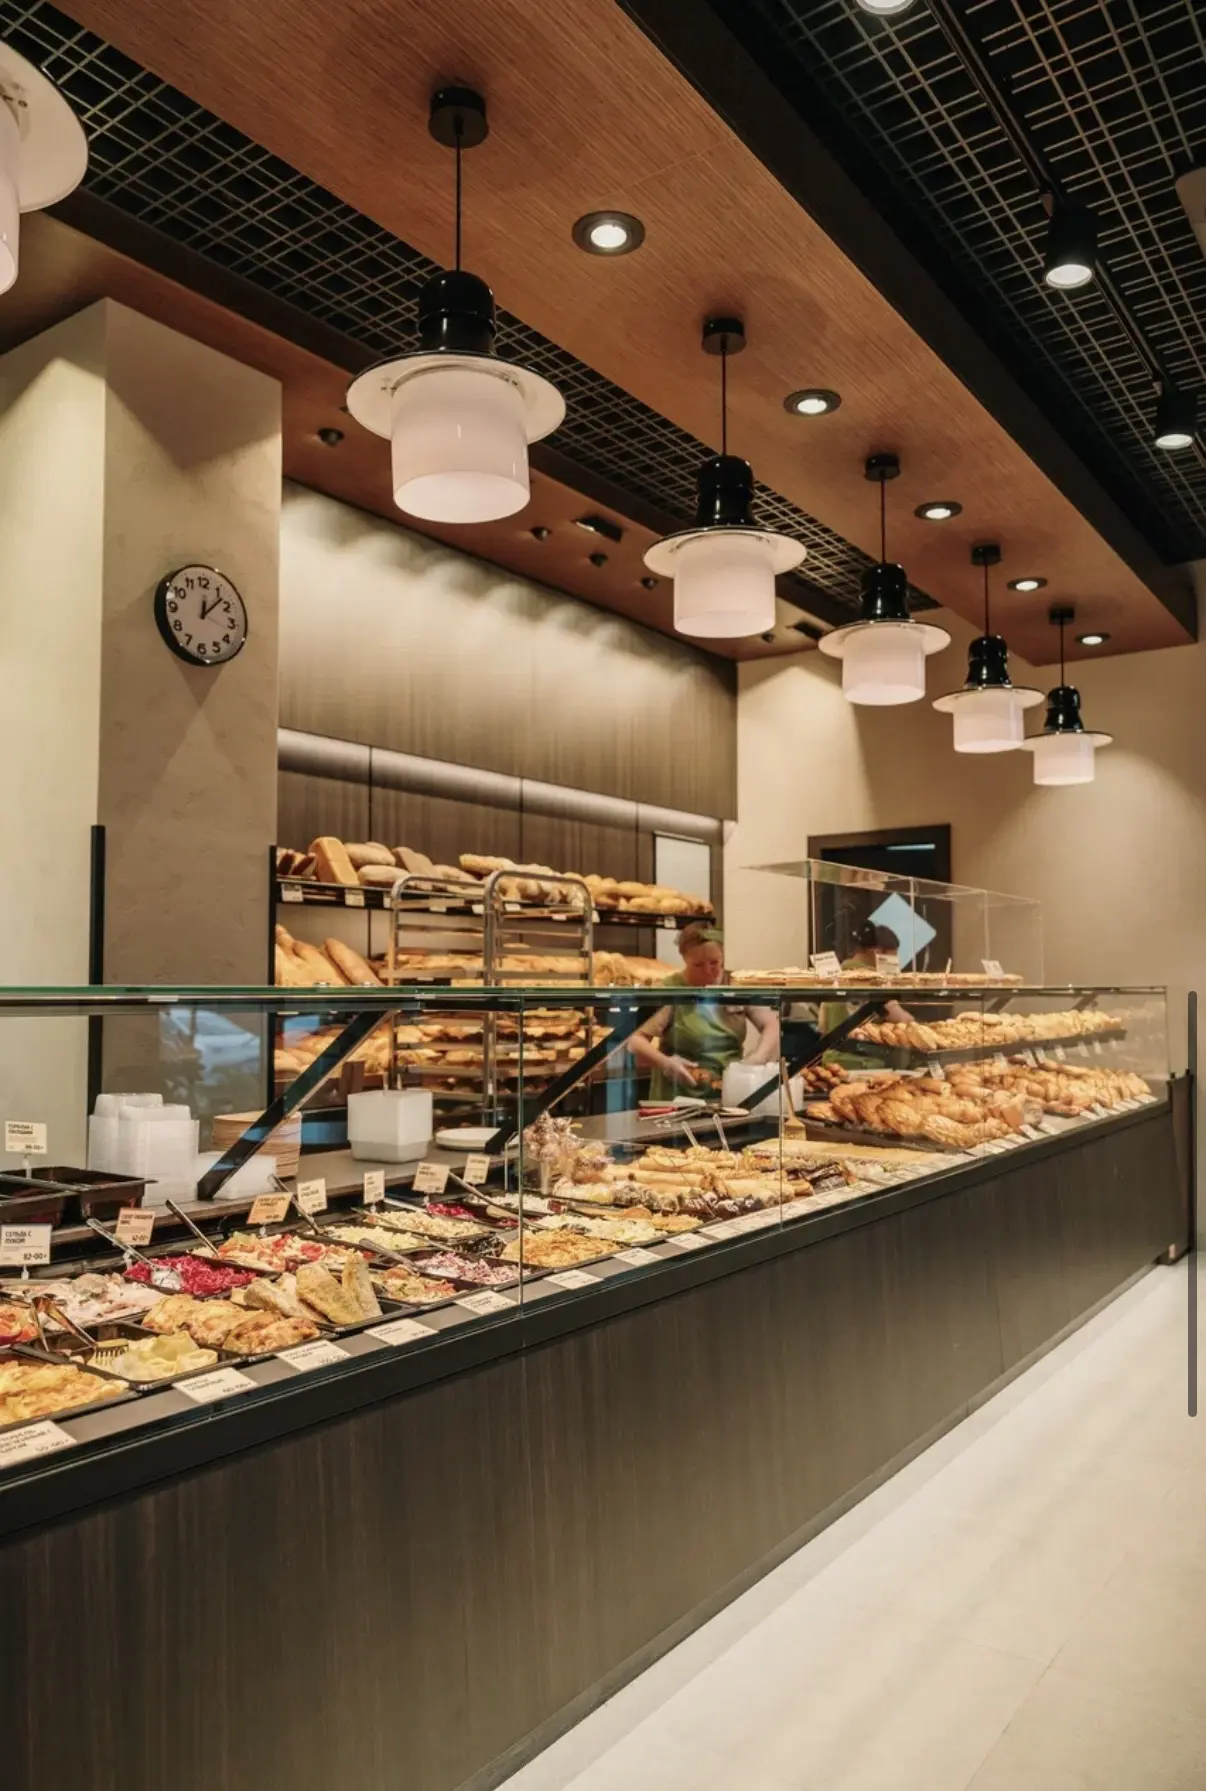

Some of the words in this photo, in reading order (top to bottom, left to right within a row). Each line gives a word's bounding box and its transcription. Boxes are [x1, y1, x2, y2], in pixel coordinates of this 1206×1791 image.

[185, 577, 194, 590] 11
[198, 576, 210, 590] 12
[174, 586, 186, 599] 10
[216, 587, 220, 598] 1
[168, 601, 178, 612] 9
[222, 601, 231, 612] 2
[173, 620, 182, 632] 8
[228, 618, 236, 630] 3
[184, 633, 193, 646] 7
[222, 633, 230, 644] 4
[197, 643, 207, 655] 6
[212, 641, 221, 653] 5
